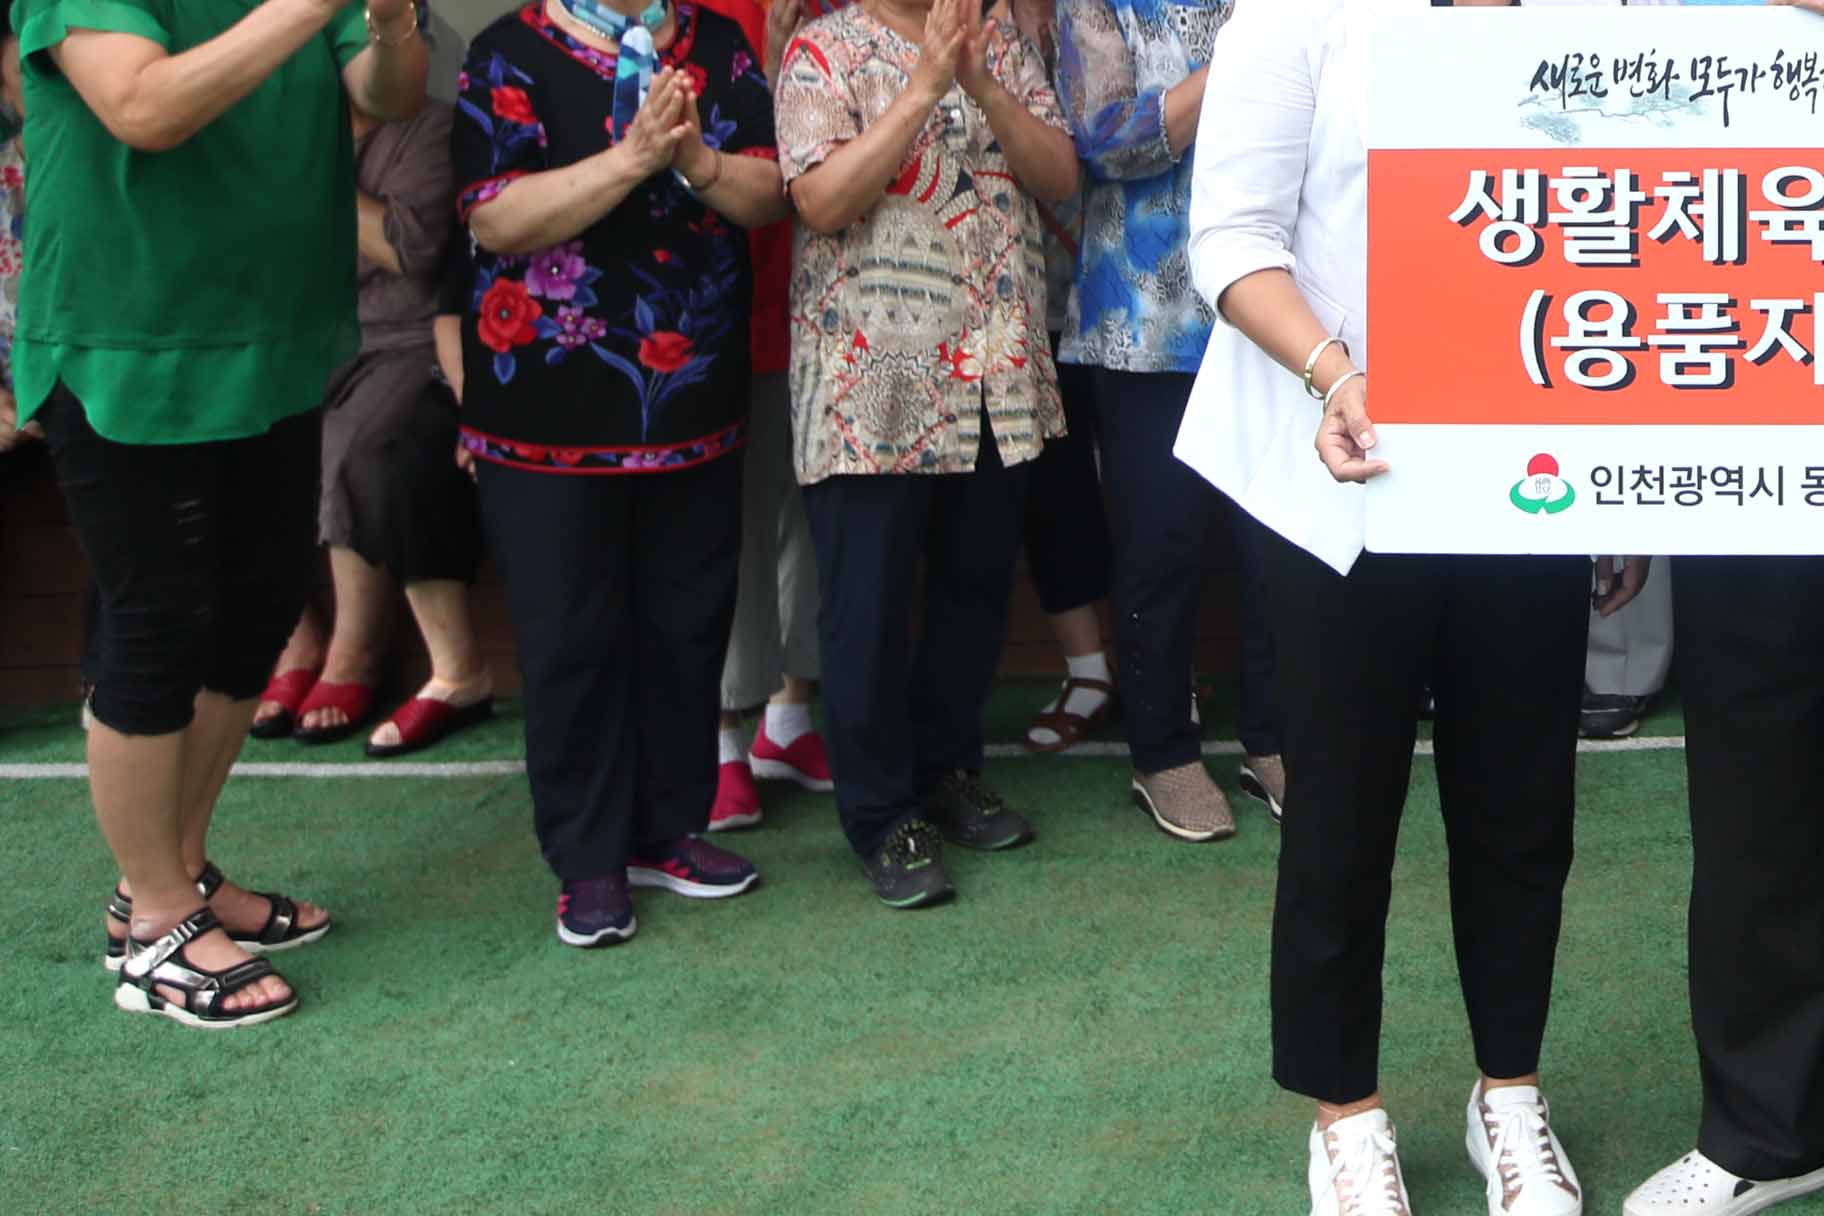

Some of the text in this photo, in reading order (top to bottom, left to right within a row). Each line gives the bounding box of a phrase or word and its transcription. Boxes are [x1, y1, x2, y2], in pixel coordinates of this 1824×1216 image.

[1529, 52, 1608, 110] 새로운
[1613, 48, 1681, 101] 변화
[1688, 55, 1767, 128] 모두가
[1588, 465, 1786, 508] 인천광역시
